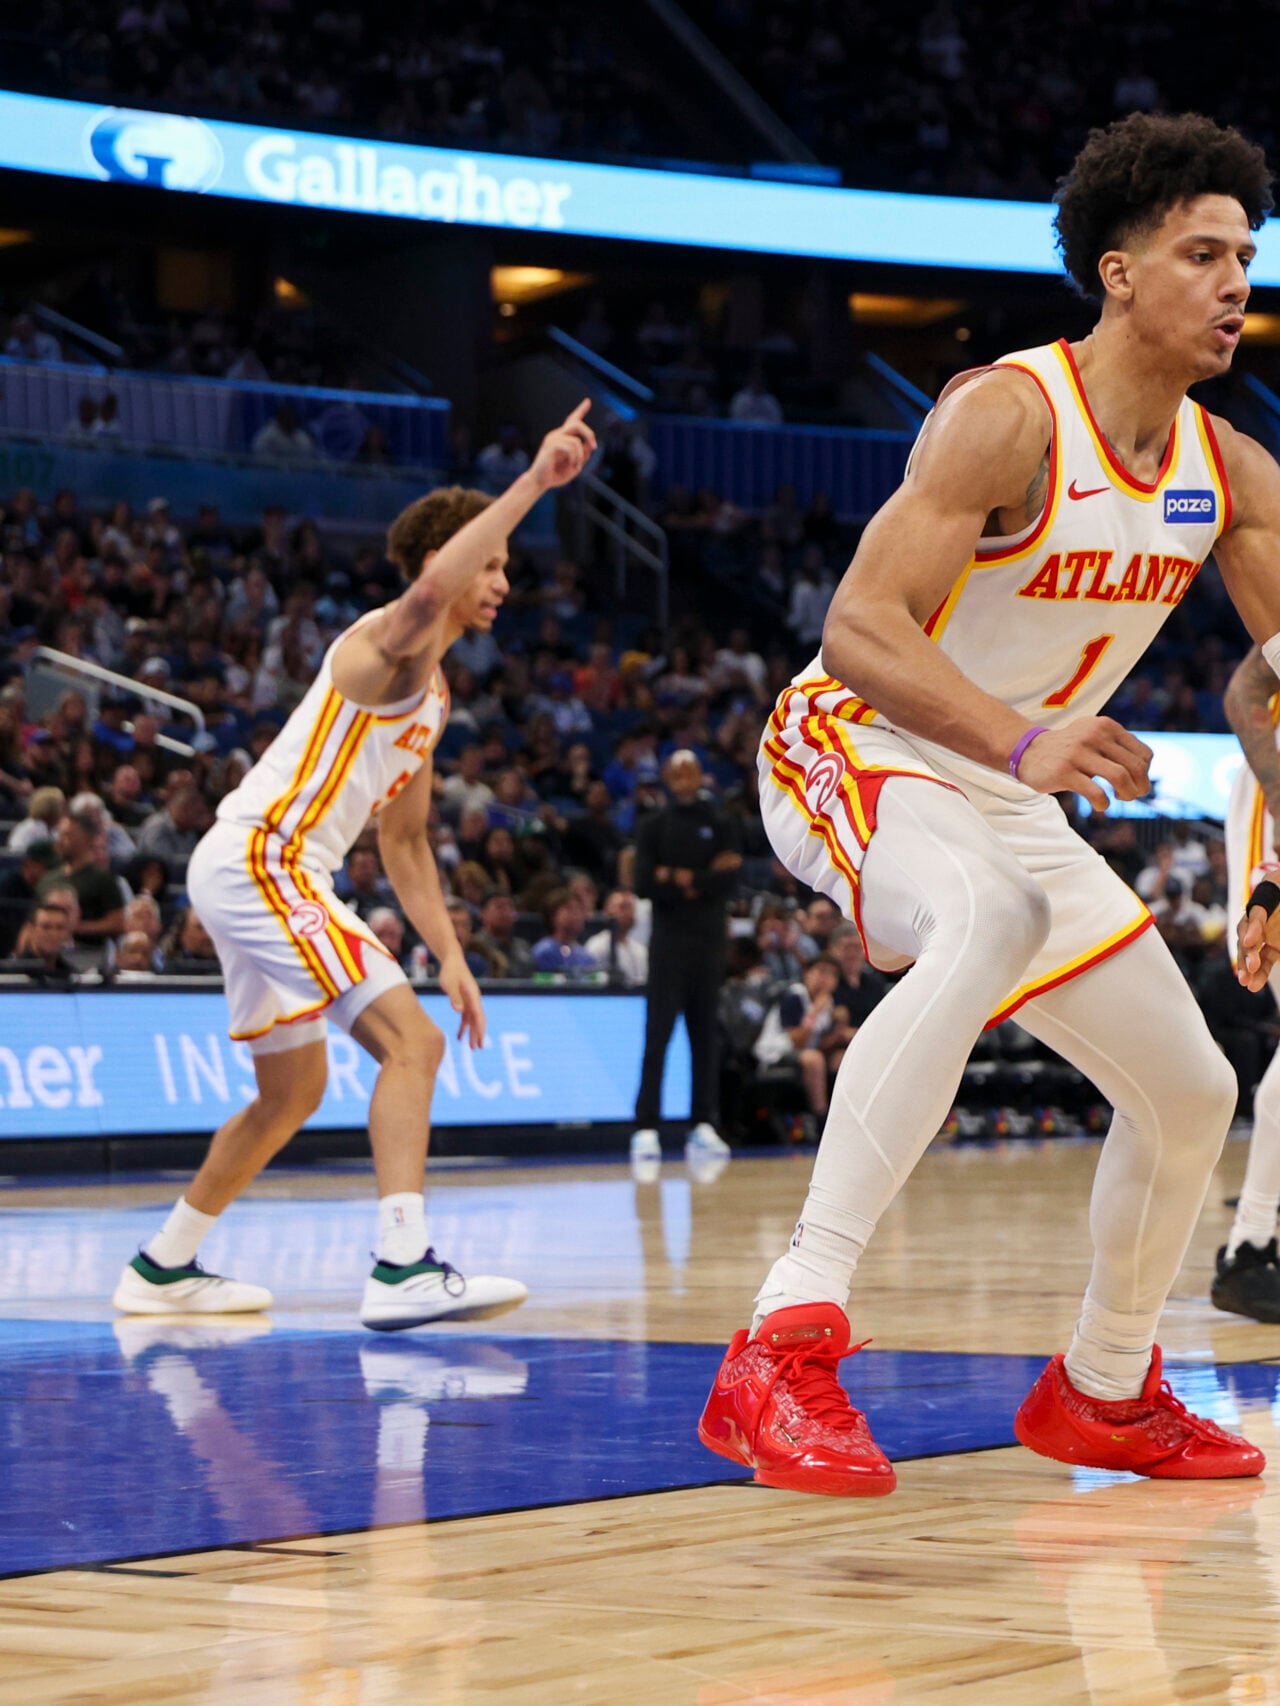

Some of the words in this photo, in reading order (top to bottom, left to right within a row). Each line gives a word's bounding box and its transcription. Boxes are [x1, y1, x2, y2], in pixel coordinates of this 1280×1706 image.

[244, 133, 572, 229] Gallagher
[1166, 498, 1213, 517] paze
[1042, 634, 1115, 708] 1
